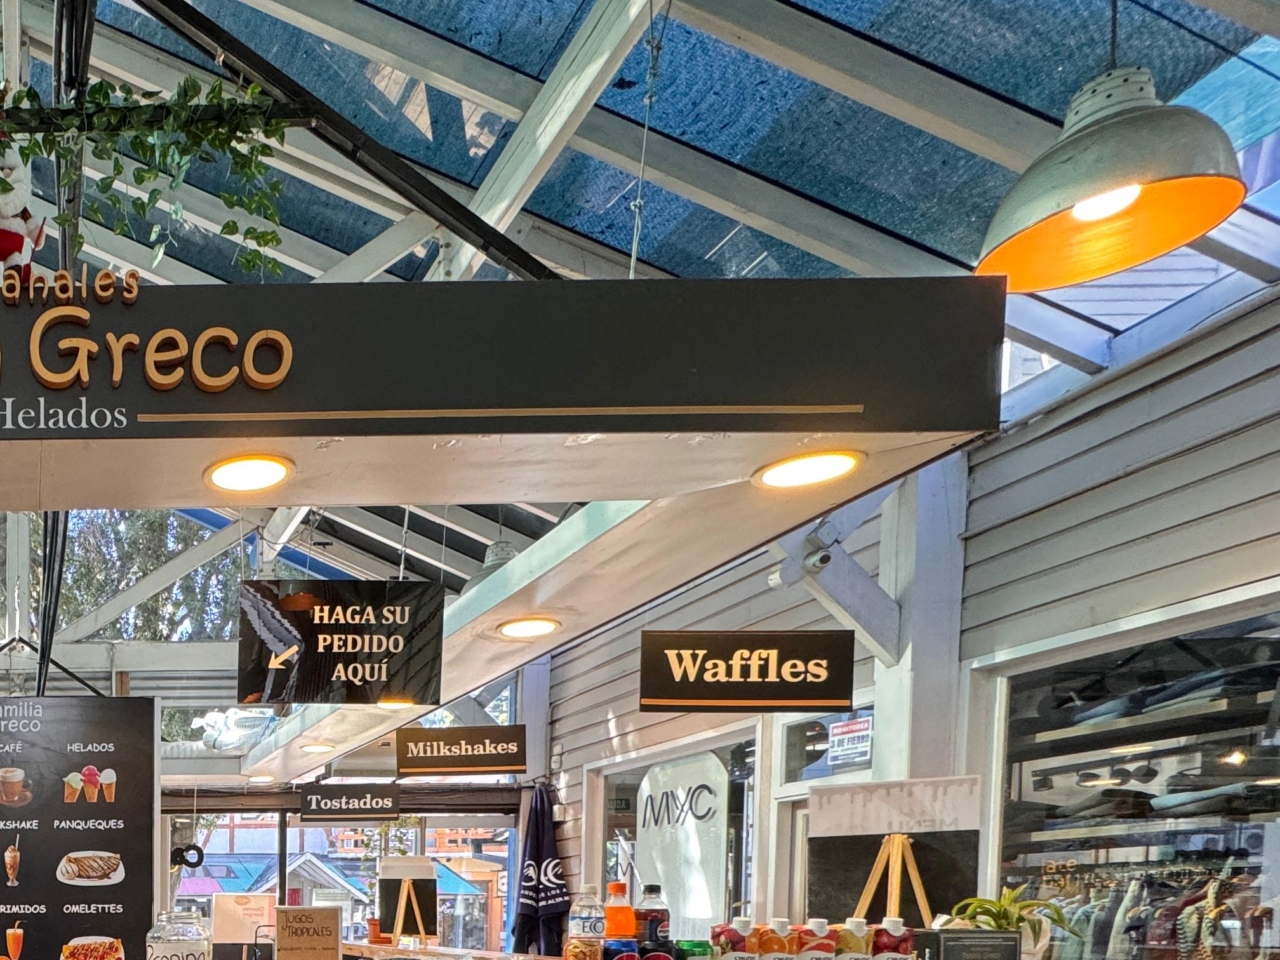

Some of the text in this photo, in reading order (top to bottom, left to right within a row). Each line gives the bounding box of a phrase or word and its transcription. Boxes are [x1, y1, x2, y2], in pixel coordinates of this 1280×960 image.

[29, 306, 295, 392] Greco
[313, 605, 410, 624] HAGA SU
[318, 634, 404, 654] PEDIDO
[331, 659, 389, 682] AQUÍ
[664, 647, 828, 683] Waffles
[67, 743, 115, 752] HELADOS
[406, 739, 518, 759] Milkshakes
[307, 794, 393, 812] Tostados
[54, 819, 124, 830] PANQUEQUES
[63, 904, 123, 913] OMELETTES
[280, 911, 314, 930] JUGOS
[287, 926, 332, 937] TROPICALES
